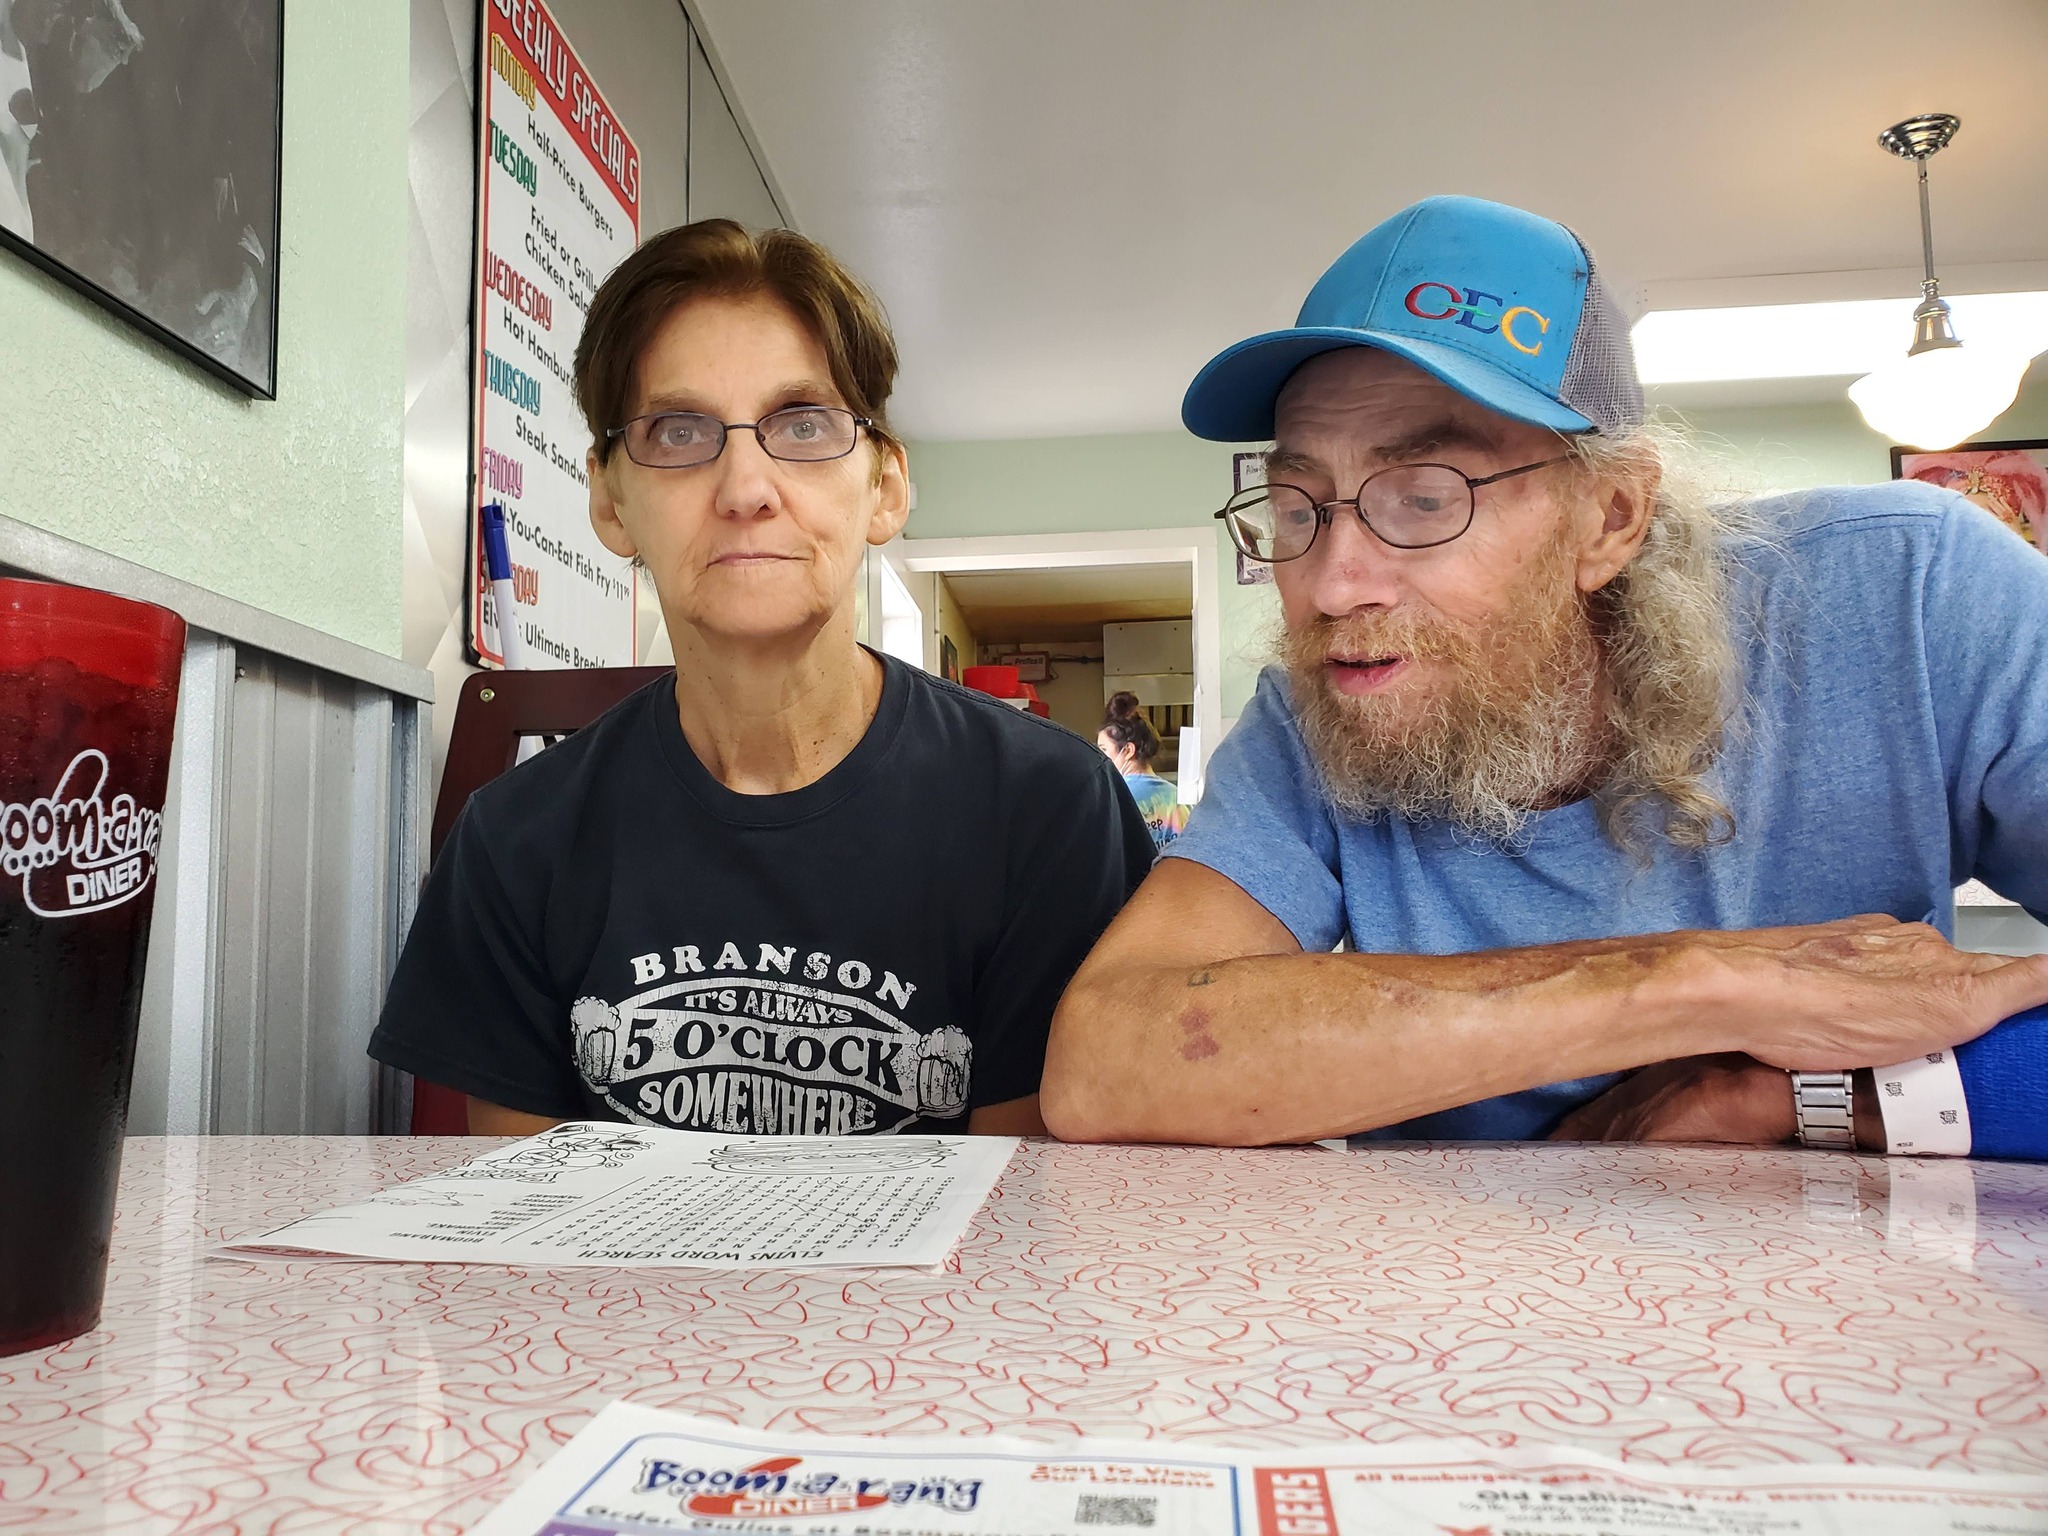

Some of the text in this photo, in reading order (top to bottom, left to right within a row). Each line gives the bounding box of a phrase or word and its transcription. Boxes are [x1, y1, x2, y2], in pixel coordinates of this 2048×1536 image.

[491, 32, 536, 111] MONDAY
[489, 118, 537, 197] TUESDAY
[571, 71, 637, 203] SPECIALS
[527, 113, 613, 241] Half-Price Burgers
[525, 232, 565, 292] Chicken
[531, 204, 557, 252] Fried
[560, 246, 571, 266] or
[485, 248, 552, 331] WEDNESDAY
[503, 306, 524, 344] Hot
[484, 349, 541, 417] THURSDAY
[516, 414, 547, 458] Steak
[481, 447, 523, 500] FRIDAY
[576, 552, 594, 582] Fish
[597, 566, 611, 597] Fry
[526, 622, 570, 664] Ultimate
[66, 857, 141, 905] DINER
[630, 942, 916, 1010] BRANSON
[684, 990, 853, 1024] IT'S ALWAYS
[624, 1017, 903, 1091] 5 O'CLOCK
[638, 1072, 877, 1136] SOMEWHERE
[577, 1249, 824, 1260] ELVINS WORD SEARCH
[733, 1498, 860, 1516] DINER
